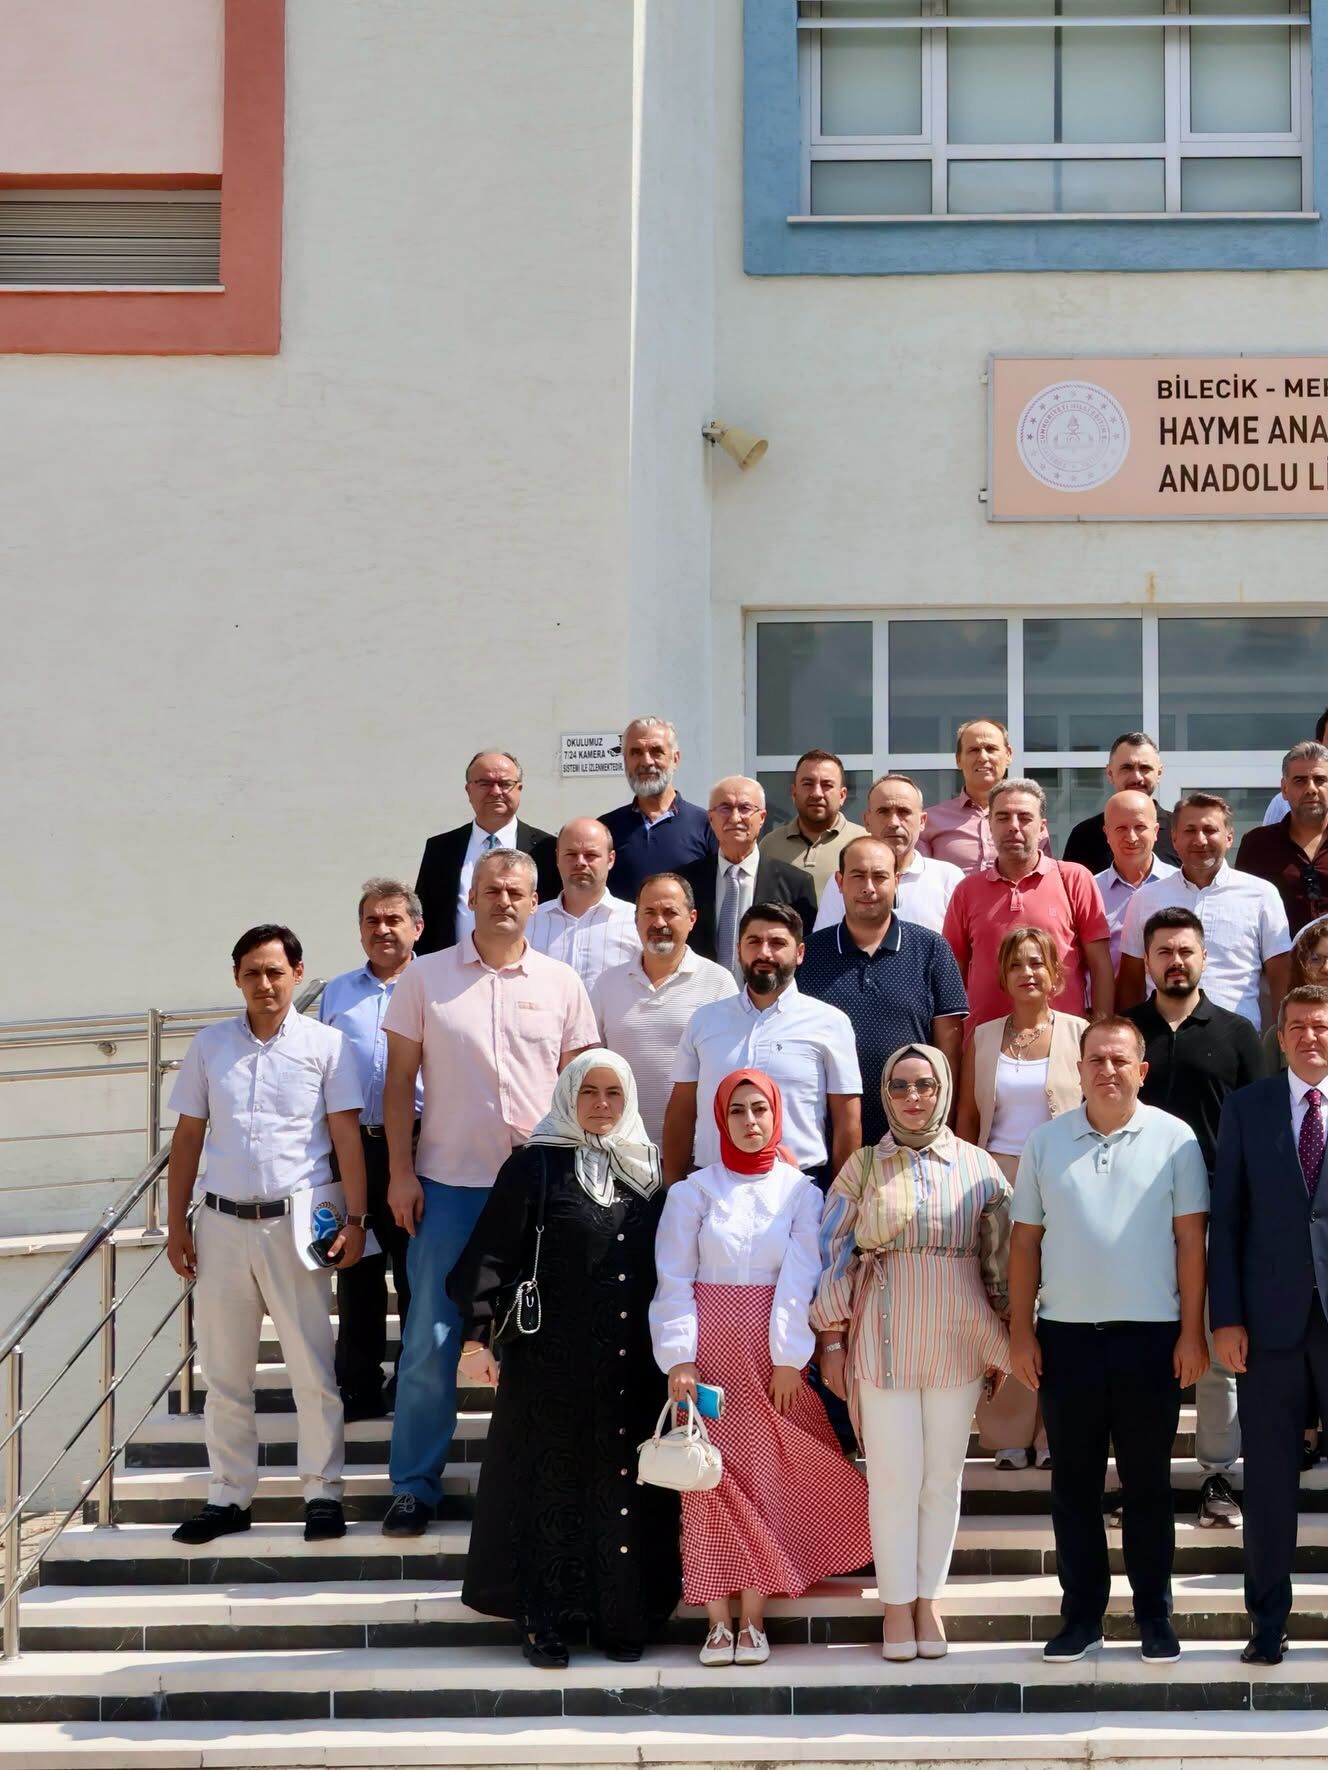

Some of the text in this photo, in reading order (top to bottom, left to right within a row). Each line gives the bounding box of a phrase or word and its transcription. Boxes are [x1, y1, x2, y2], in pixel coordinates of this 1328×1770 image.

[1157, 372, 1259, 400] BİLECİK
[1159, 415, 1260, 446] HAYME
[1158, 461, 1299, 493] ANADOLU
[564, 749, 606, 759] 7/24 KAMERA
[566, 737, 603, 747] OKULUMUZ
